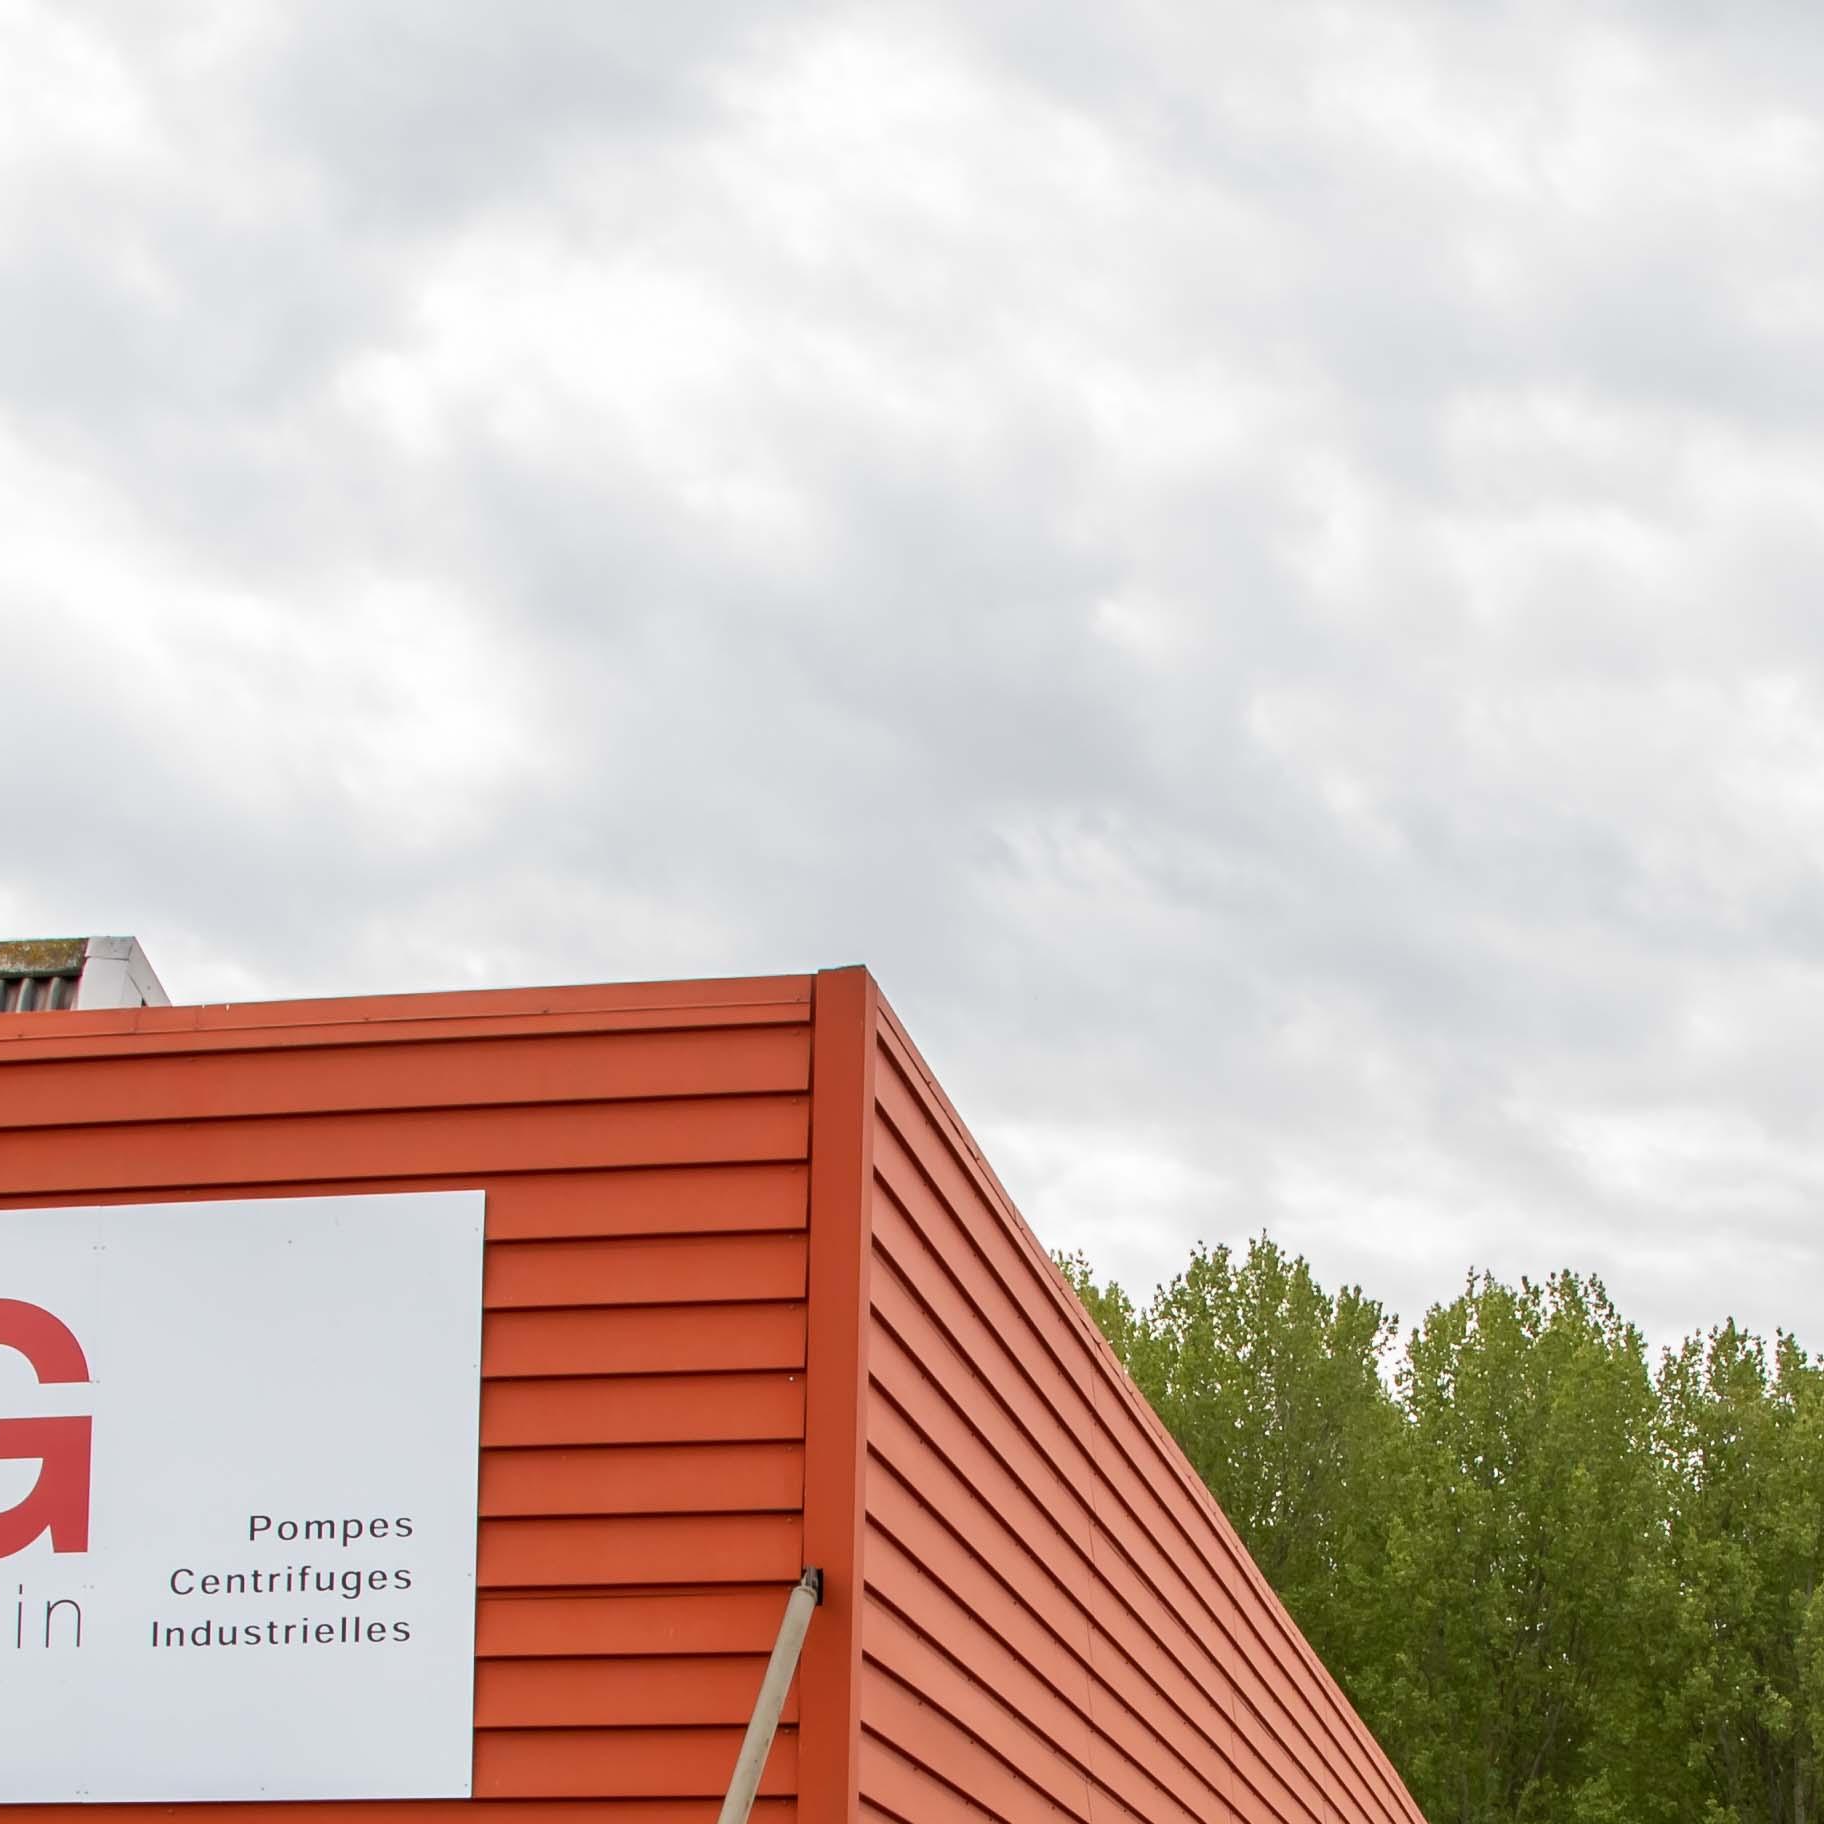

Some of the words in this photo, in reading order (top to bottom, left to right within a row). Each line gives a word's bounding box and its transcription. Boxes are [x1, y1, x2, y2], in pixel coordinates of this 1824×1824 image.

[248, 1514, 414, 1548] Pompes
[169, 1564, 413, 1600] Centrifuges
[151, 1614, 412, 1649] Industrielles
